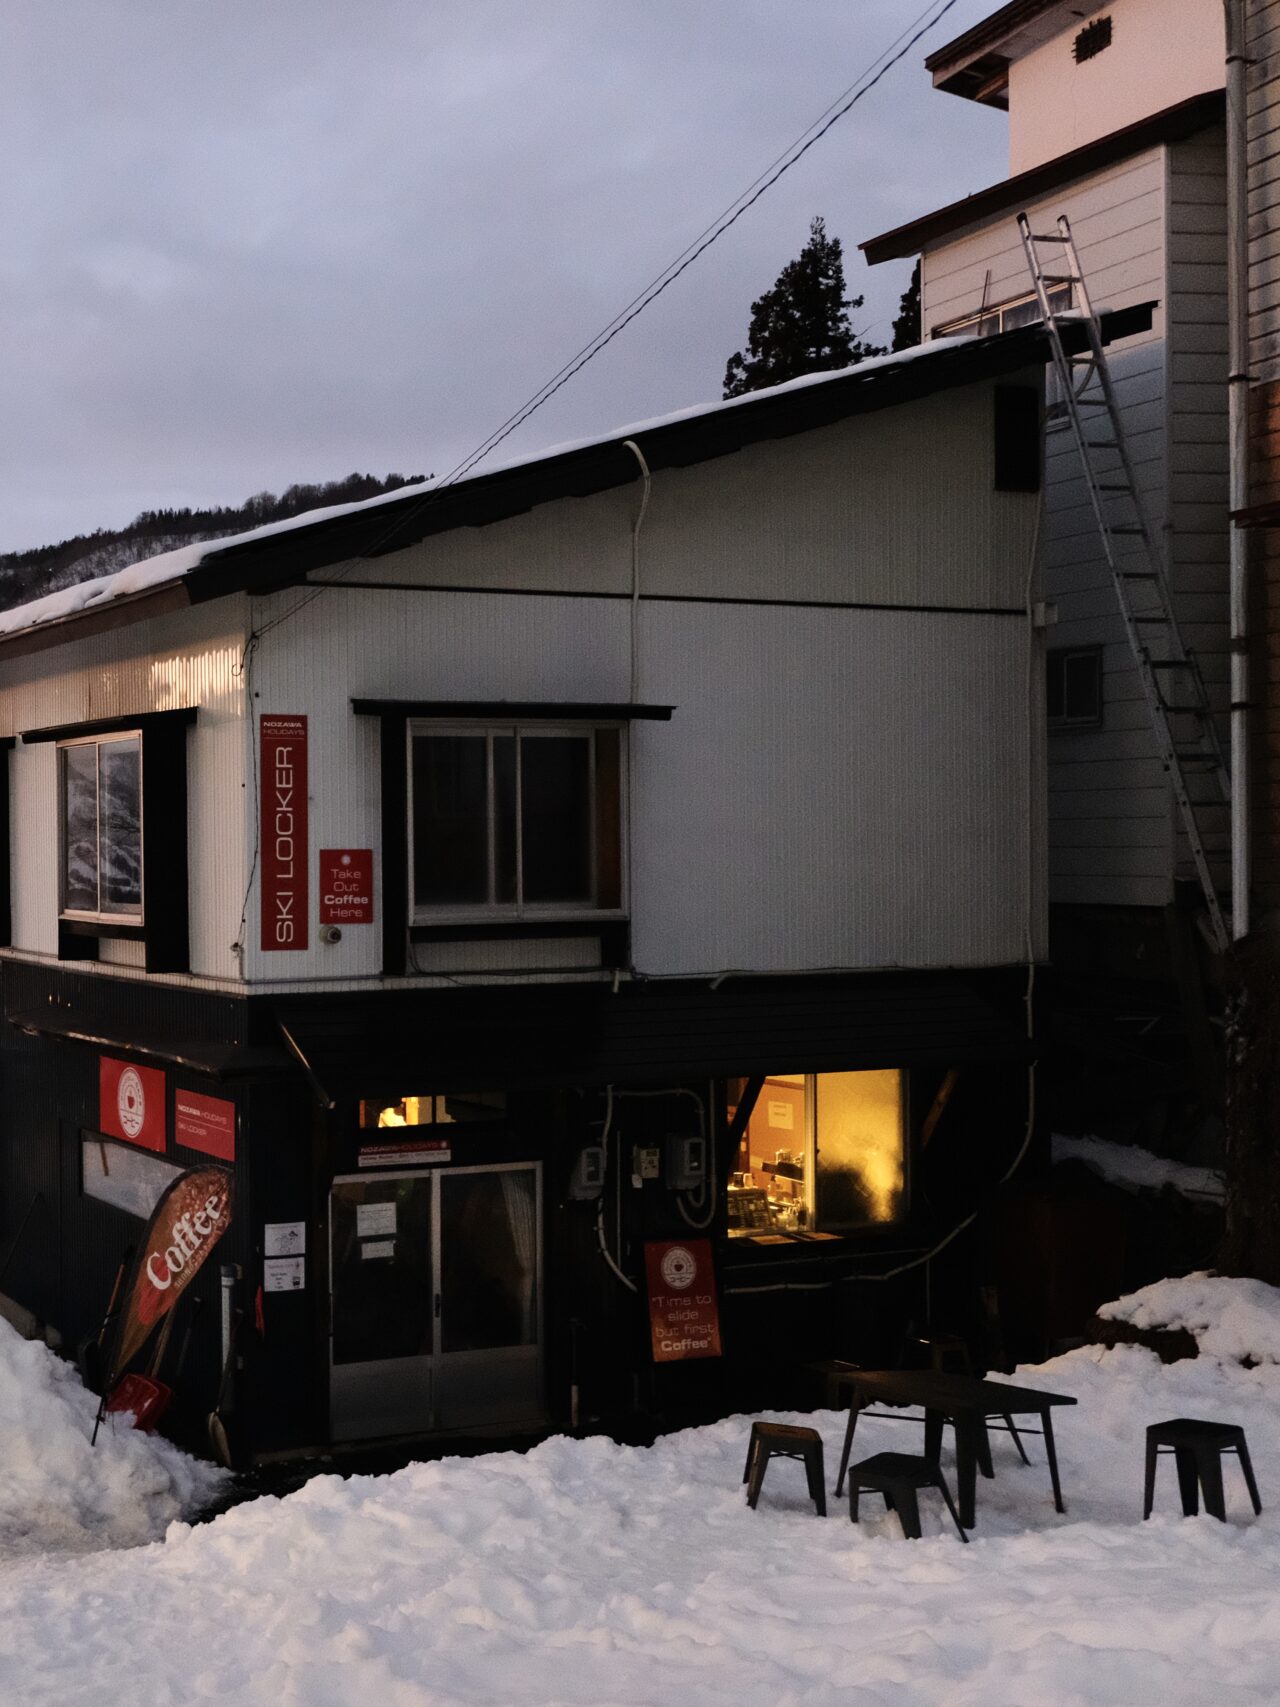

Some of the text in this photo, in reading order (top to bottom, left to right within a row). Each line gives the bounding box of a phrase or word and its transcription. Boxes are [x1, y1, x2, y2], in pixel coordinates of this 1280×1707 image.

[276, 747, 294, 942] SKI LOCKER
[330, 869, 362, 879] Take
[333, 882, 360, 892] Out
[324, 895, 369, 905] Coffee
[329, 908, 363, 917] Here
[146, 1195, 221, 1290] Coffee
[695, 1295, 712, 1305] to
[668, 1310, 699, 1322] slide
[655, 1323, 715, 1338] but first
